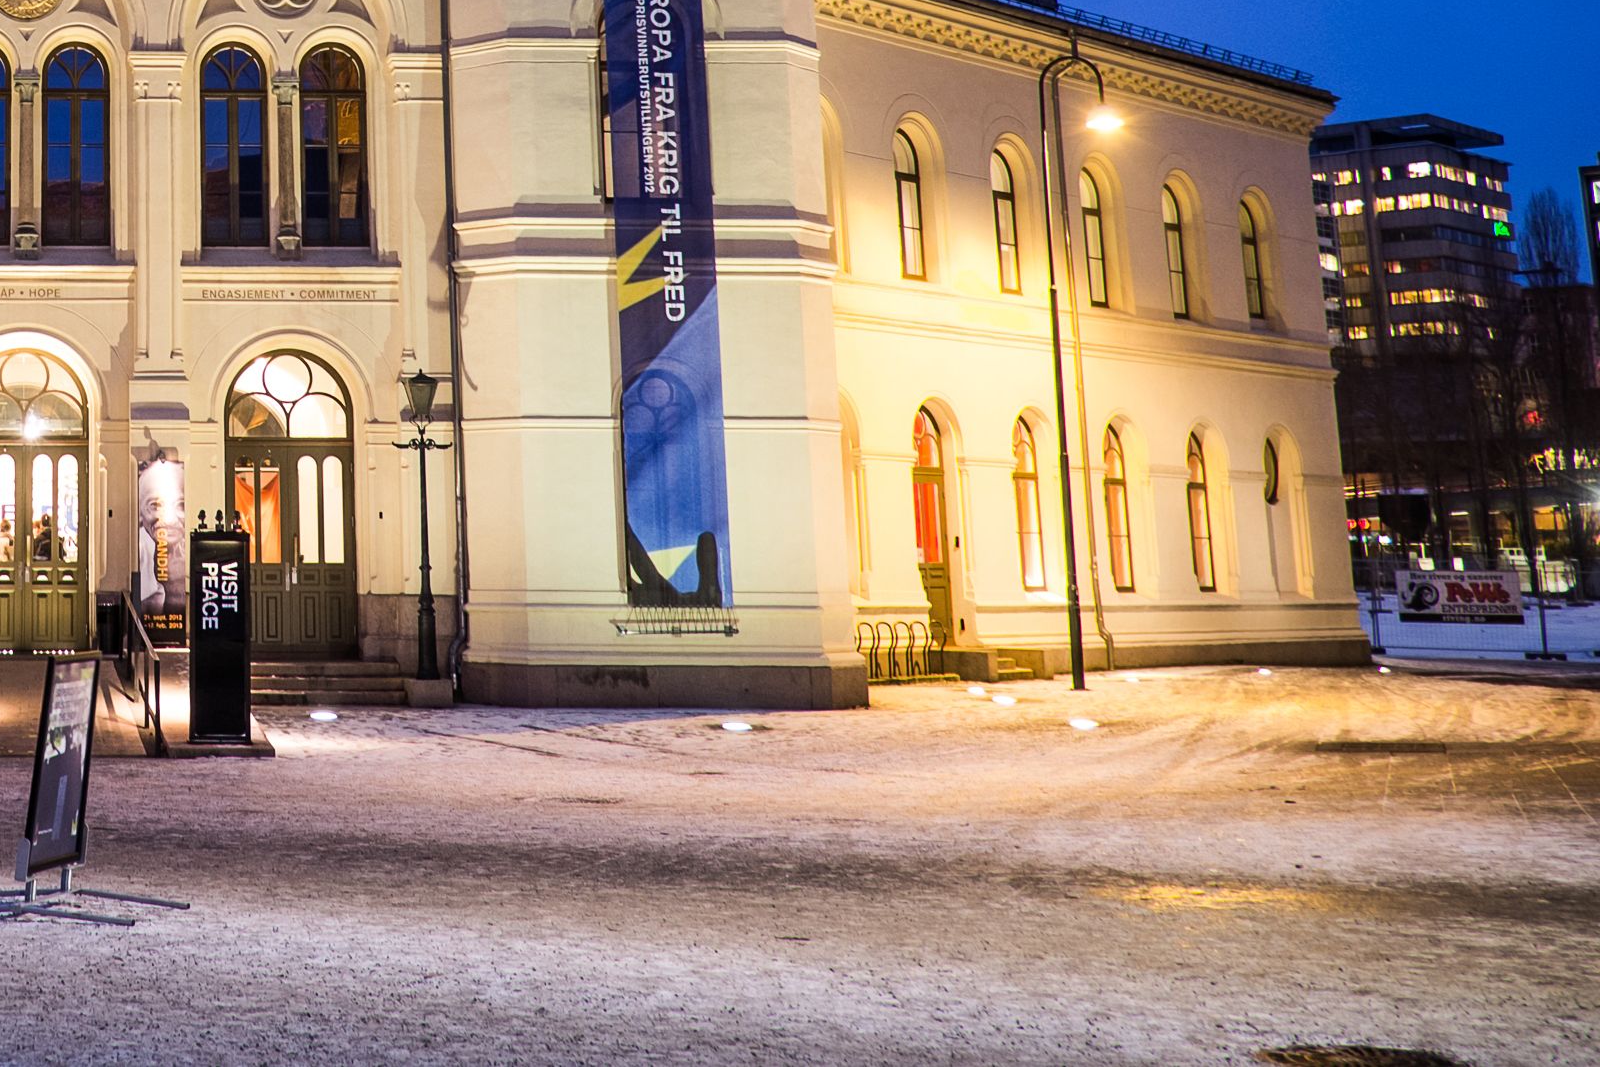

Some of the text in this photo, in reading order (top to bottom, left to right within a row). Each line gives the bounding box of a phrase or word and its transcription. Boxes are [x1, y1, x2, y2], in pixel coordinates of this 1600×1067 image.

[653, 71, 675, 125] FRA
[643, 166, 655, 193] 2012
[657, 131, 680, 196] KRIG
[660, 203, 682, 243] TIL
[29, 288, 62, 298] HOPE
[201, 288, 378, 300] ENGASJEMENT COMMITMENT
[662, 249, 686, 323] FRED
[157, 528, 168, 581] GANDHI
[201, 562, 219, 630] PEACE
[221, 562, 238, 612] VISIT
[1445, 581, 1511, 603] PeWe
